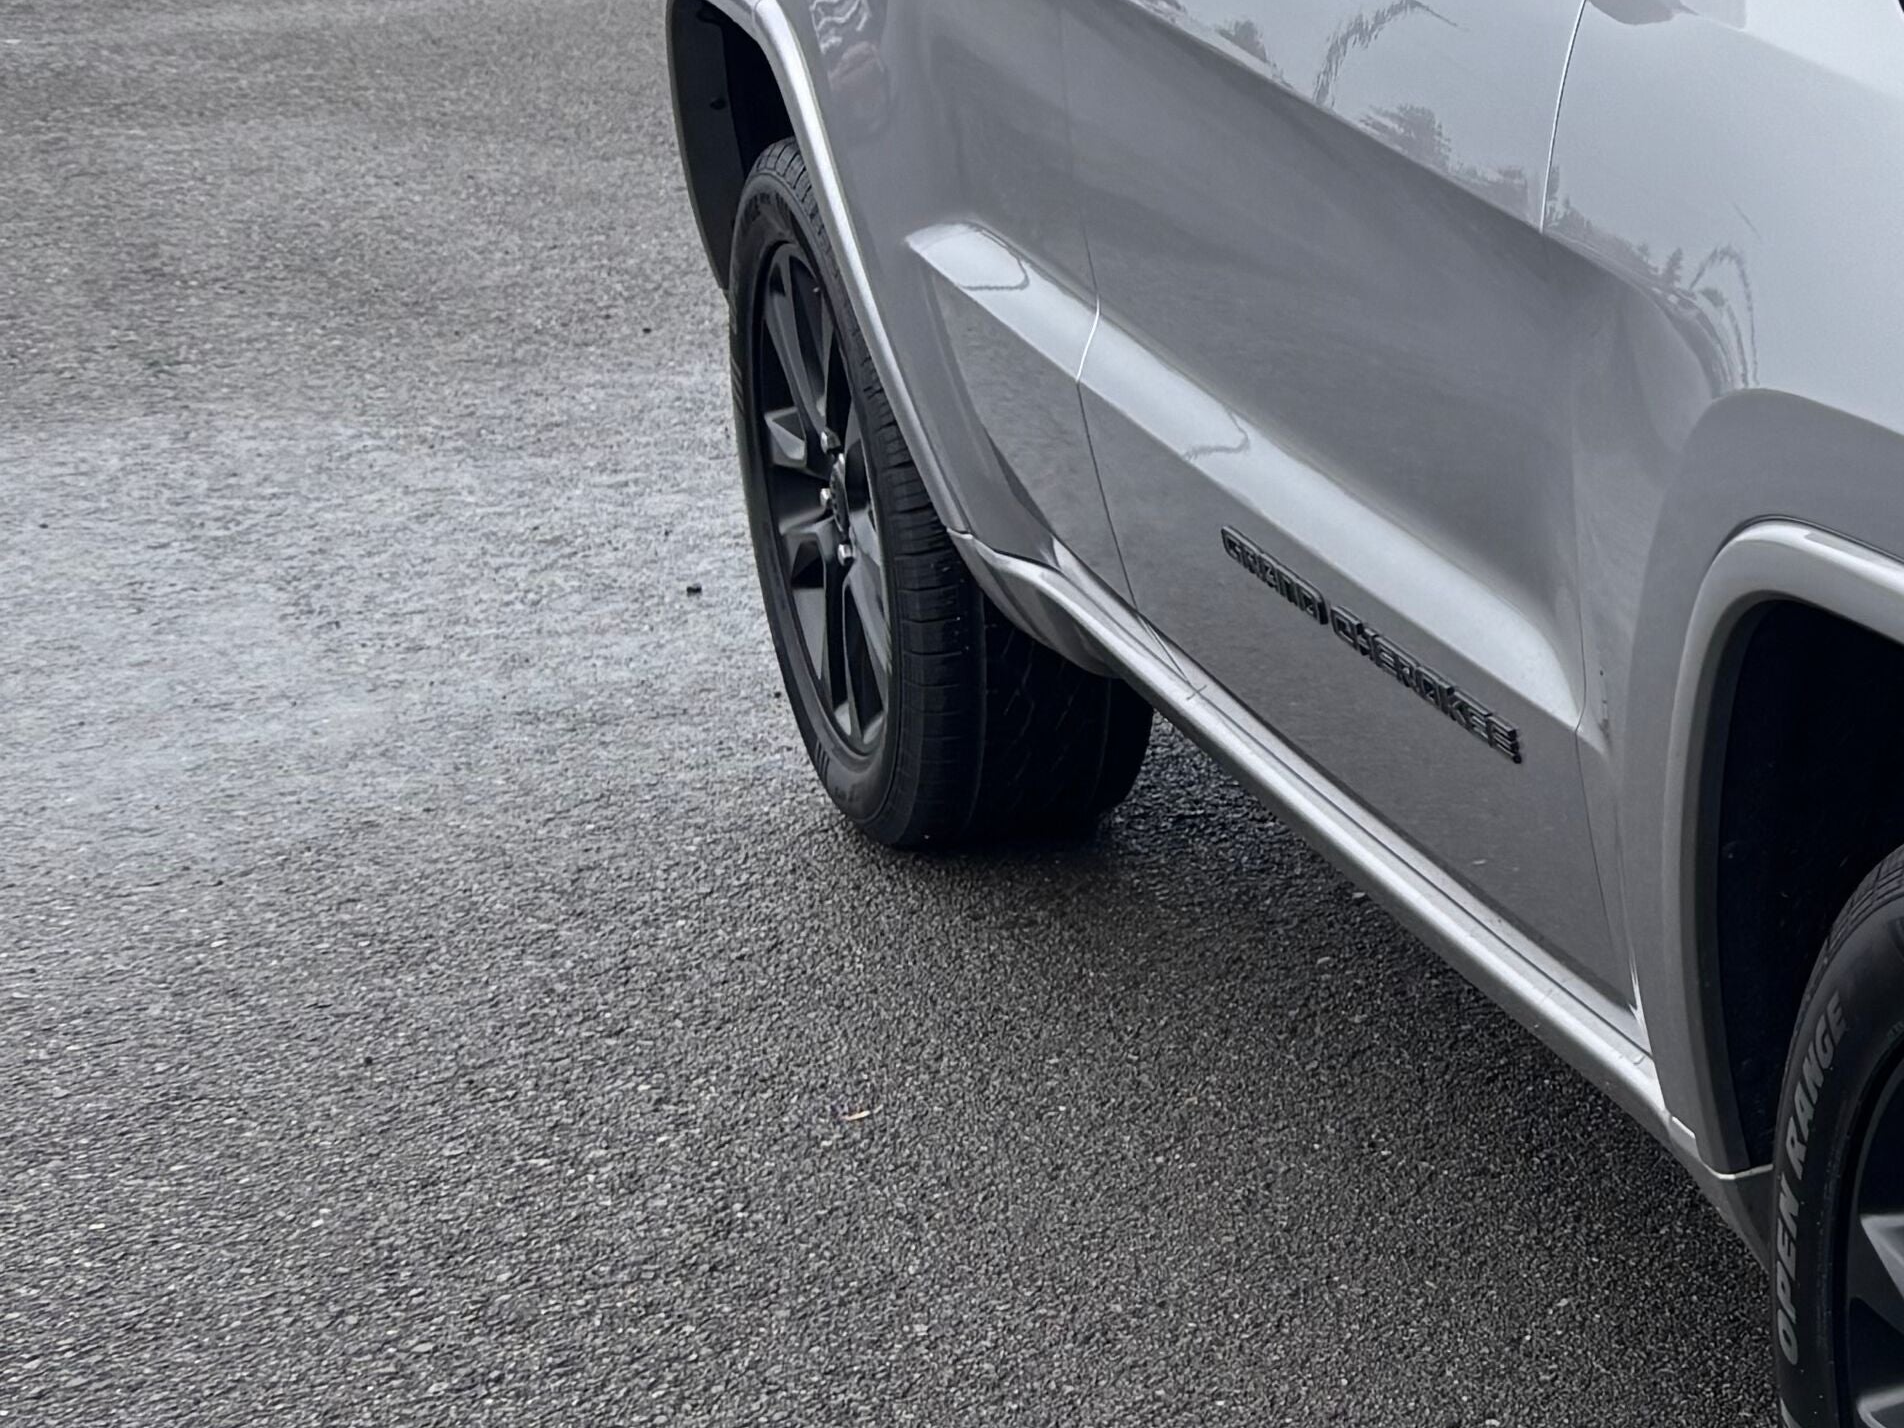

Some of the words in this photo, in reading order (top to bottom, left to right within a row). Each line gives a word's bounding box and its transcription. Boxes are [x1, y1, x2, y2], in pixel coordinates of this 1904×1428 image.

[1220, 525, 1329, 625] GRAND
[1331, 604, 1523, 764] CHEROKEE
[1784, 990, 1848, 1180] RANGE
[1777, 1170, 1801, 1366] OPEN
